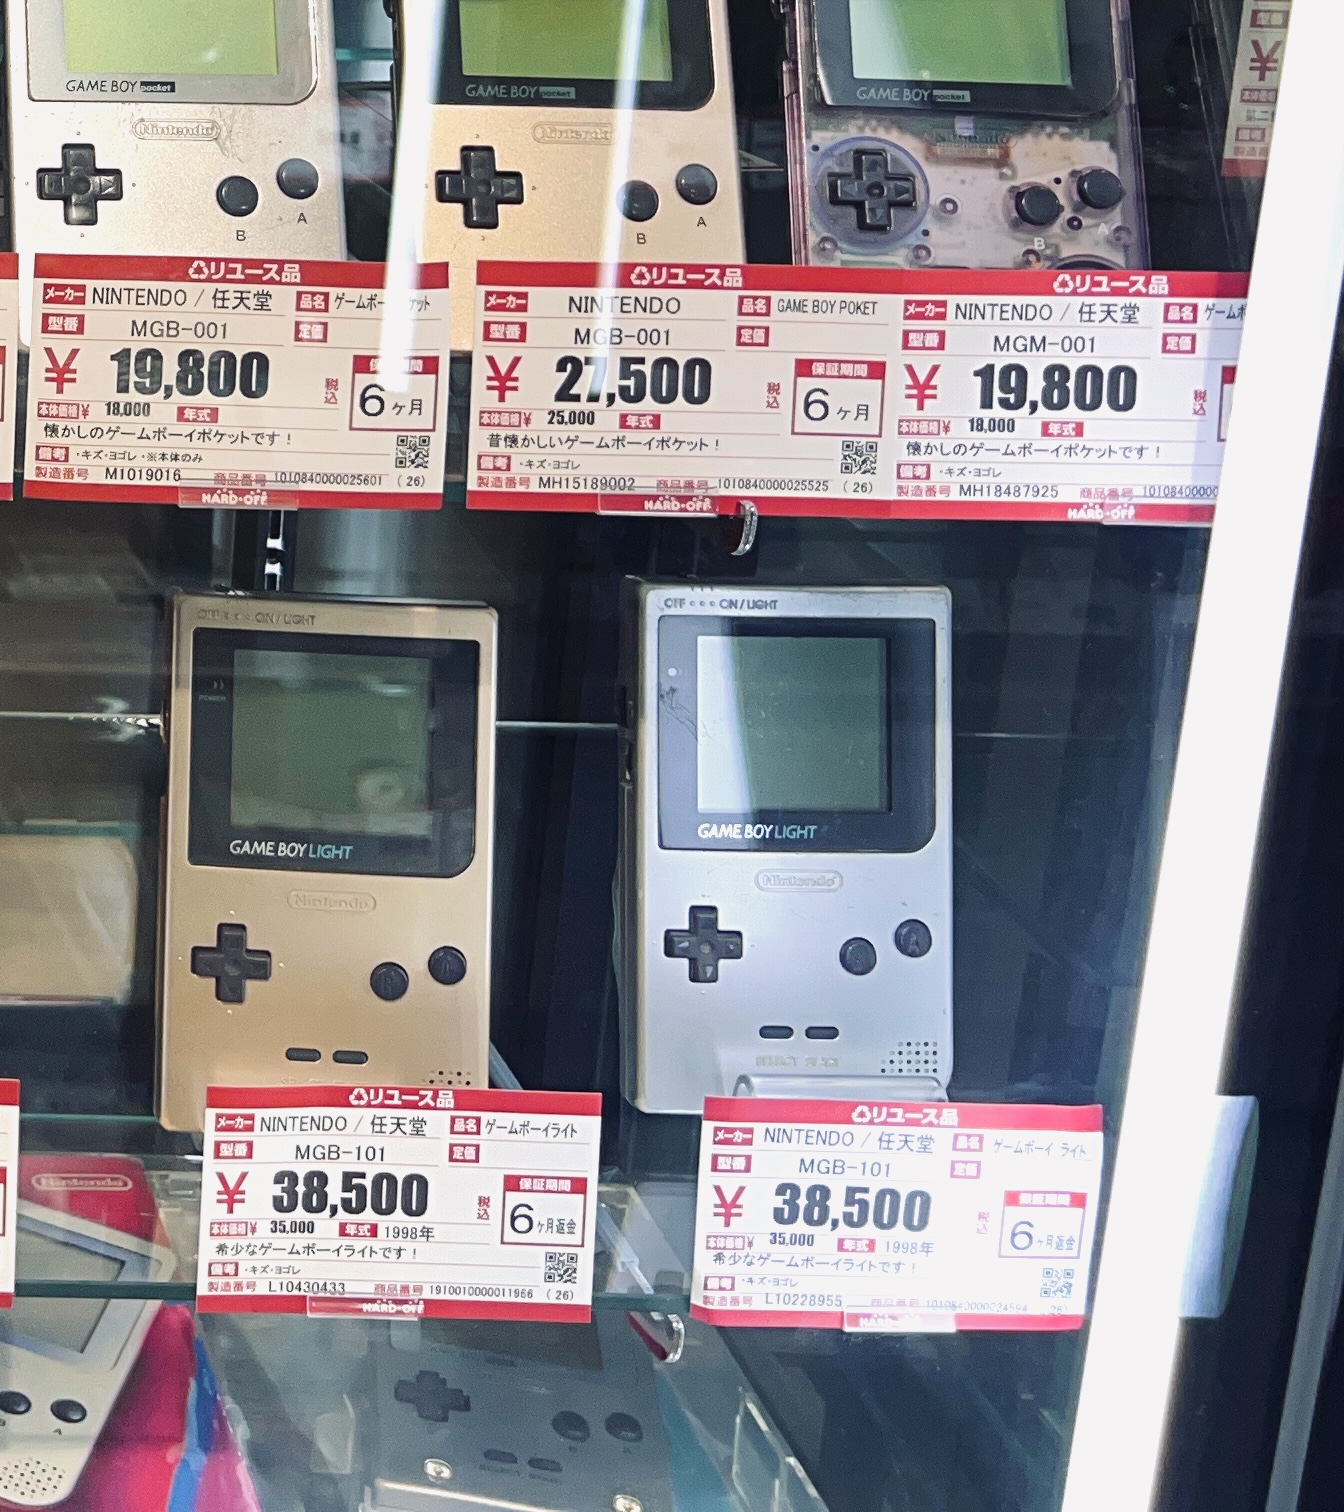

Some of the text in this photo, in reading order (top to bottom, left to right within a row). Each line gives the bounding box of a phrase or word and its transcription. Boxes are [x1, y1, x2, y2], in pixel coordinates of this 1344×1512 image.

[65, 79, 174, 92] GAME BOY pocket
[568, 295, 682, 315] NINTENDO
[776, 298, 878, 316] GAME BOY POKET
[954, 302, 1053, 322] NINTENDO
[573, 327, 671, 347] MGB-001
[992, 334, 1096, 354] MGM-001
[554, 354, 712, 409] 27,500
[972, 363, 1138, 416] 19,800
[697, 822, 818, 841] GAME BOY LIGHT
[260, 1114, 348, 1133] NINTENDO
[484, 1121, 578, 1138] ゲームボーイライト
[763, 1128, 855, 1148] NINTENDO
[295, 1145, 386, 1163] MGB-101
[799, 1157, 892, 1178] MGB-101
[272, 1169, 429, 1219] 38,500
[772, 1181, 932, 1233] 38,500
